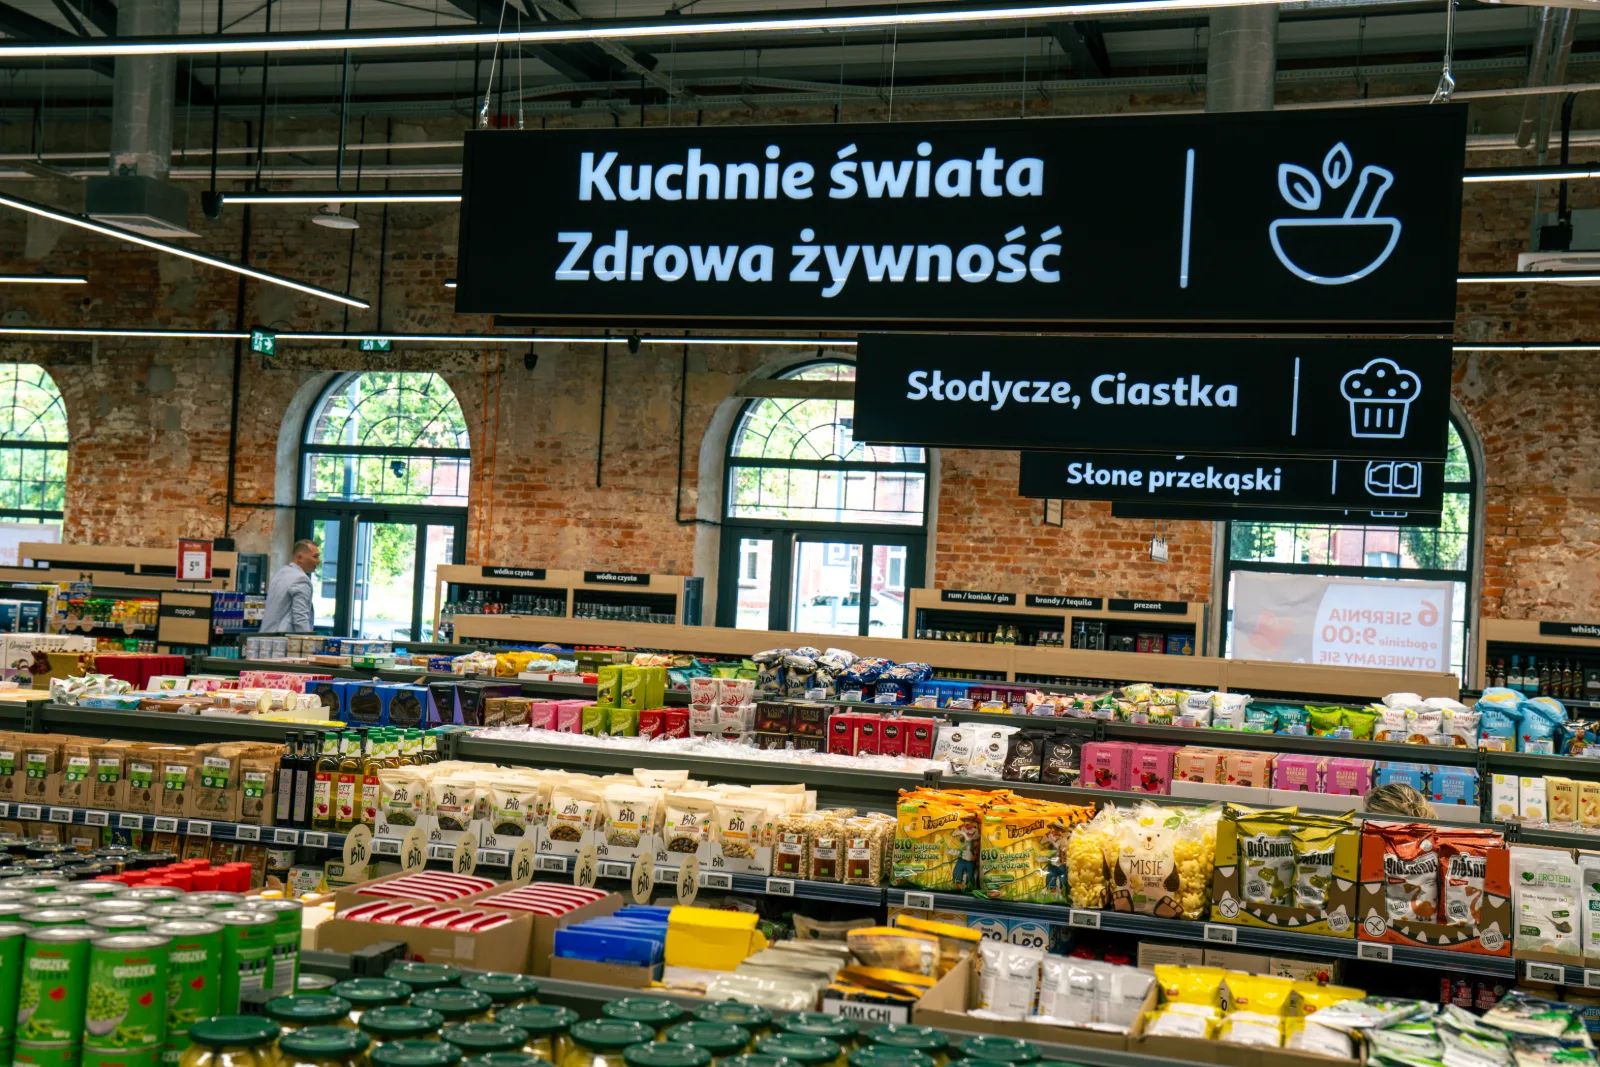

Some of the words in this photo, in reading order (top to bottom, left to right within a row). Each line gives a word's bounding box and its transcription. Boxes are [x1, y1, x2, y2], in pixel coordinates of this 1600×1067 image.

[579, 145, 815, 201] Kuchnie
[828, 141, 1044, 199] świata
[555, 230, 774, 282] Zdrowa
[789, 225, 1062, 298] żywność
[906, 370, 1081, 411] Słodycze,
[1090, 372, 1238, 407] Ciastka
[1066, 462, 1143, 487] Słone
[1148, 466, 1282, 496] przekąski
[493, 568, 514, 576] wódka
[515, 570, 534, 578] czysta
[596, 573, 617, 581] wódka
[617, 575, 638, 583] czysta
[967, 592, 992, 602] koniak
[998, 594, 1009, 604] gin
[1035, 596, 1060, 606] brandy
[1066, 598, 1092, 608] tequila
[1134, 601, 1161, 611] prezent
[175, 608, 195, 617] napoje
[1188, 697, 1208, 706] Chipsy
[893, 839, 912, 850] BIO
[981, 850, 998, 861] BIO
[1130, 860, 1163, 876] MISIE
[839, 1004, 864, 1020] KIM
[867, 1007, 891, 1023] CHI
